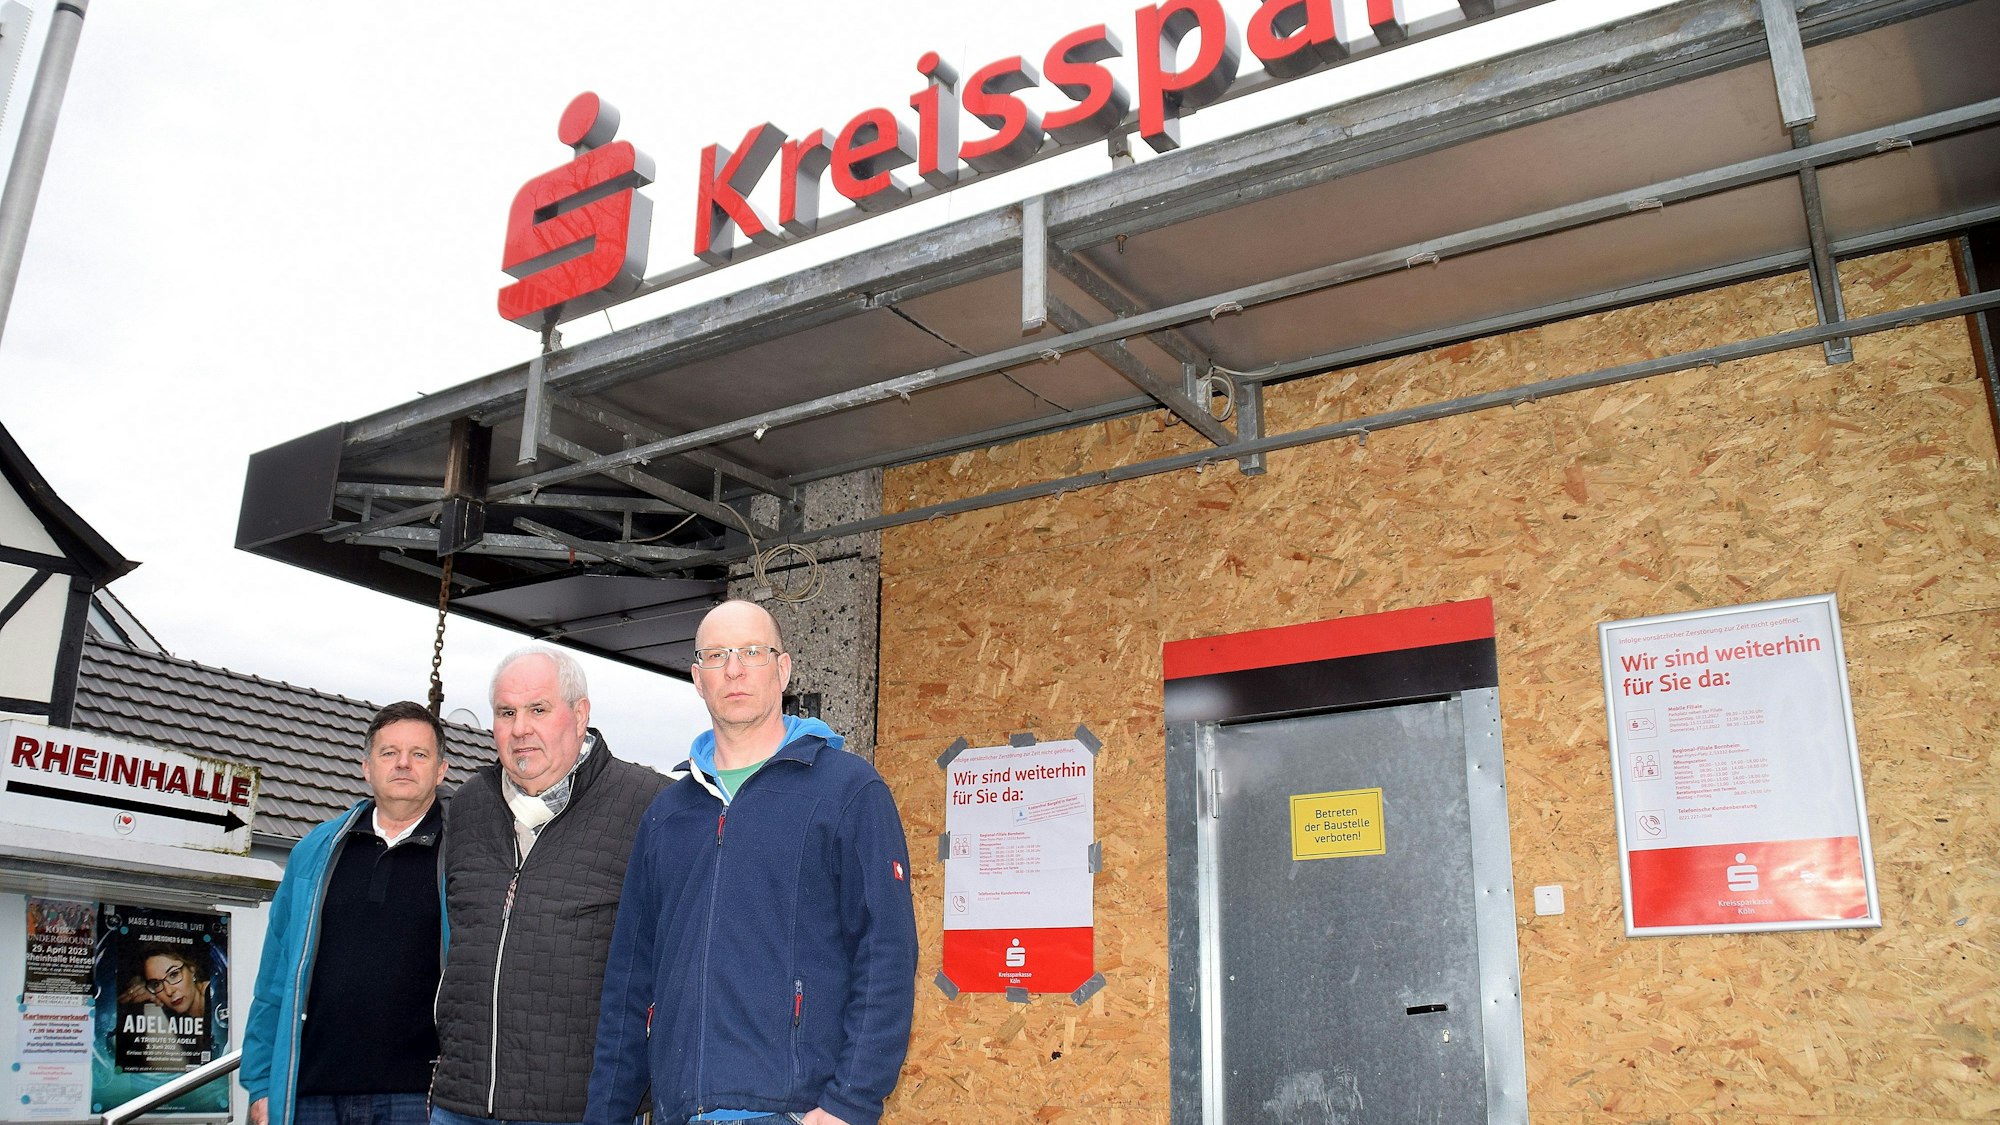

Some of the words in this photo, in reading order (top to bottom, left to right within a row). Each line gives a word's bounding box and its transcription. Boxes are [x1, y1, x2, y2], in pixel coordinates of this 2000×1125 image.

[694, 0, 1402, 262] Kreisspa
[1642, 631, 1684, 642] vorsätzlicher
[1686, 627, 1723, 638] Zerstörung
[1751, 620, 1768, 629] nicht
[1621, 652, 1658, 673] Wir
[1664, 645, 1709, 668] sind
[1714, 634, 1821, 662] weiterhin
[1623, 678, 1654, 696] für
[1659, 672, 1692, 692] Sie
[1698, 669, 1731, 688] da:
[10, 735, 252, 806] RHEINHALLE
[954, 770, 978, 786] Wir
[982, 767, 1010, 784] sind
[1015, 762, 1086, 781] weiterhin
[953, 790, 972, 806] für
[976, 788, 998, 804] Sie
[1002, 786, 1024, 802] da:
[1316, 808, 1358, 818] Betreten
[1304, 822, 1320, 832] der
[1324, 818, 1370, 830] Baustelle
[1314, 831, 1361, 843] verboten!
[1718, 898, 1773, 907] Kreissparkasse
[128, 917, 148, 926] MAGIE
[26, 953, 68, 963] Rheinhalle
[69, 956, 95, 965] Hersel
[32, 944, 44, 953] 29.
[46, 946, 67, 955] April
[68, 948, 88, 956] 2023
[123, 1014, 204, 1036] ADELAIDE
